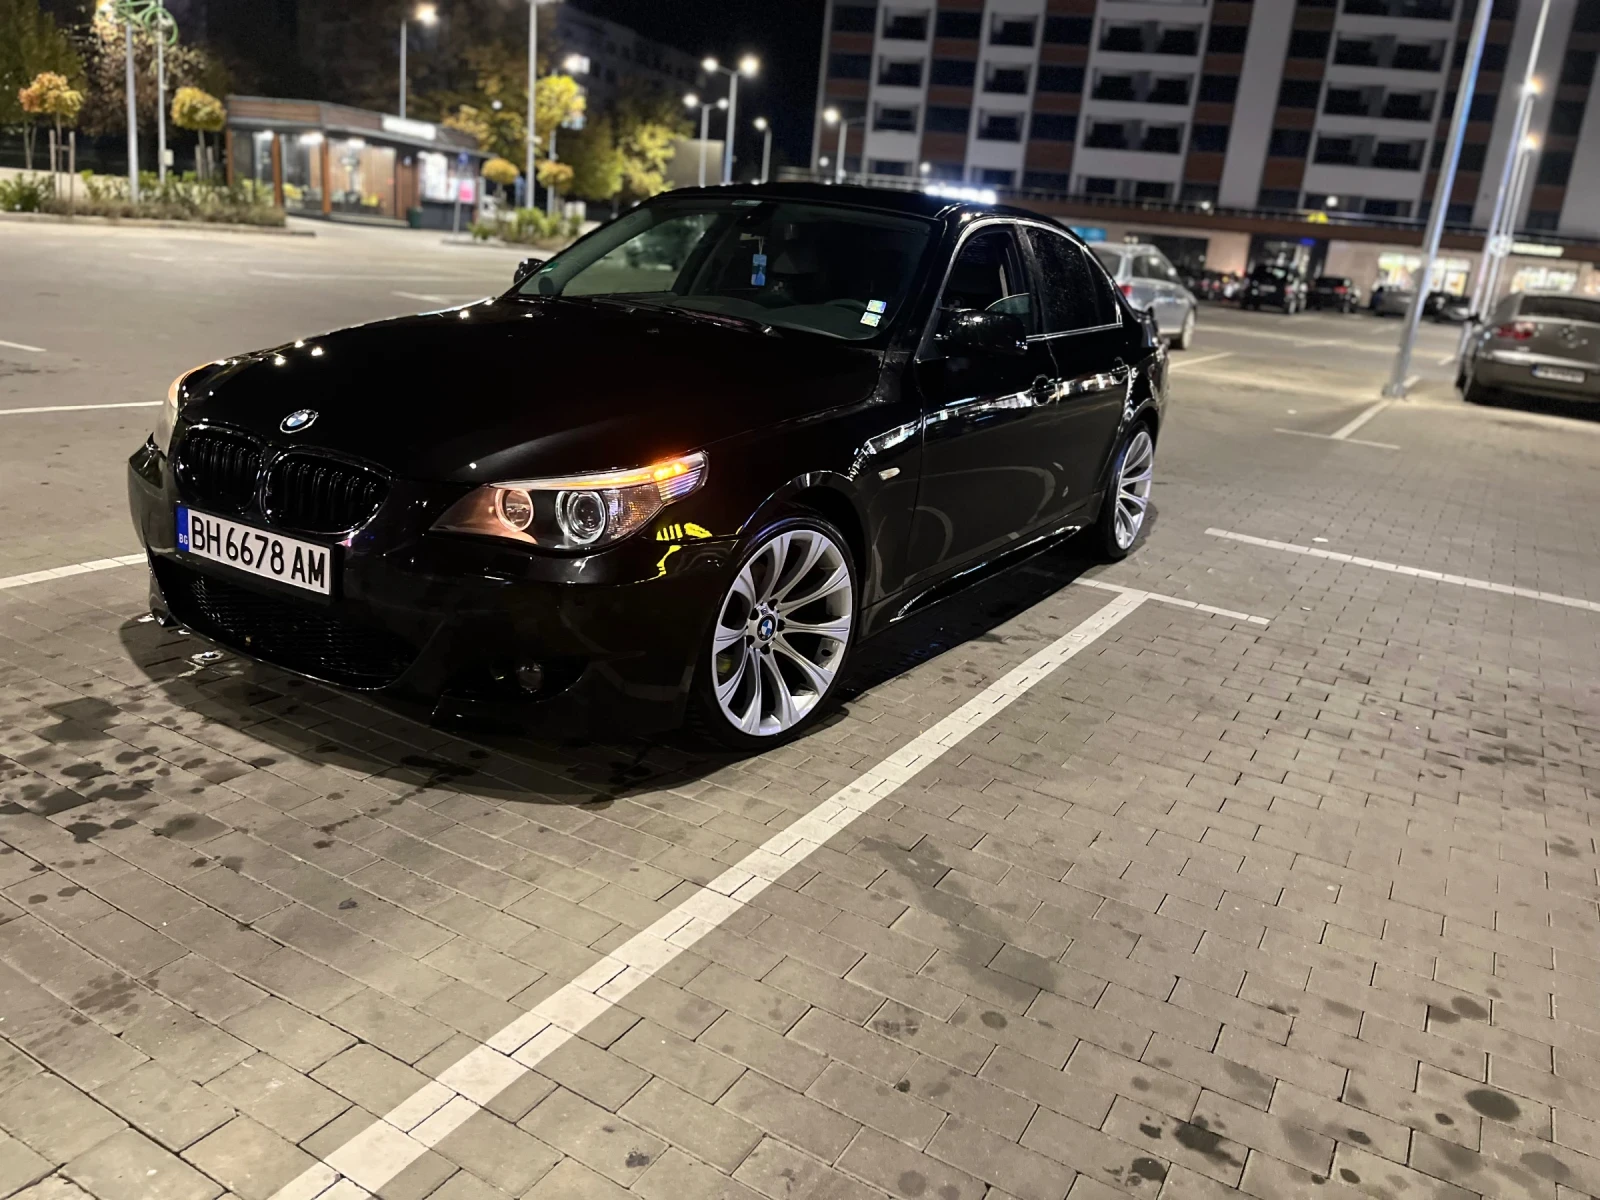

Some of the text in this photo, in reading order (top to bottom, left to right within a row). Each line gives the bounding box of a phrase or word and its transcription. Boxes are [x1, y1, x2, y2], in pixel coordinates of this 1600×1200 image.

[179, 533, 188, 544] BG
[191, 515, 325, 588] BH 6678 AM
